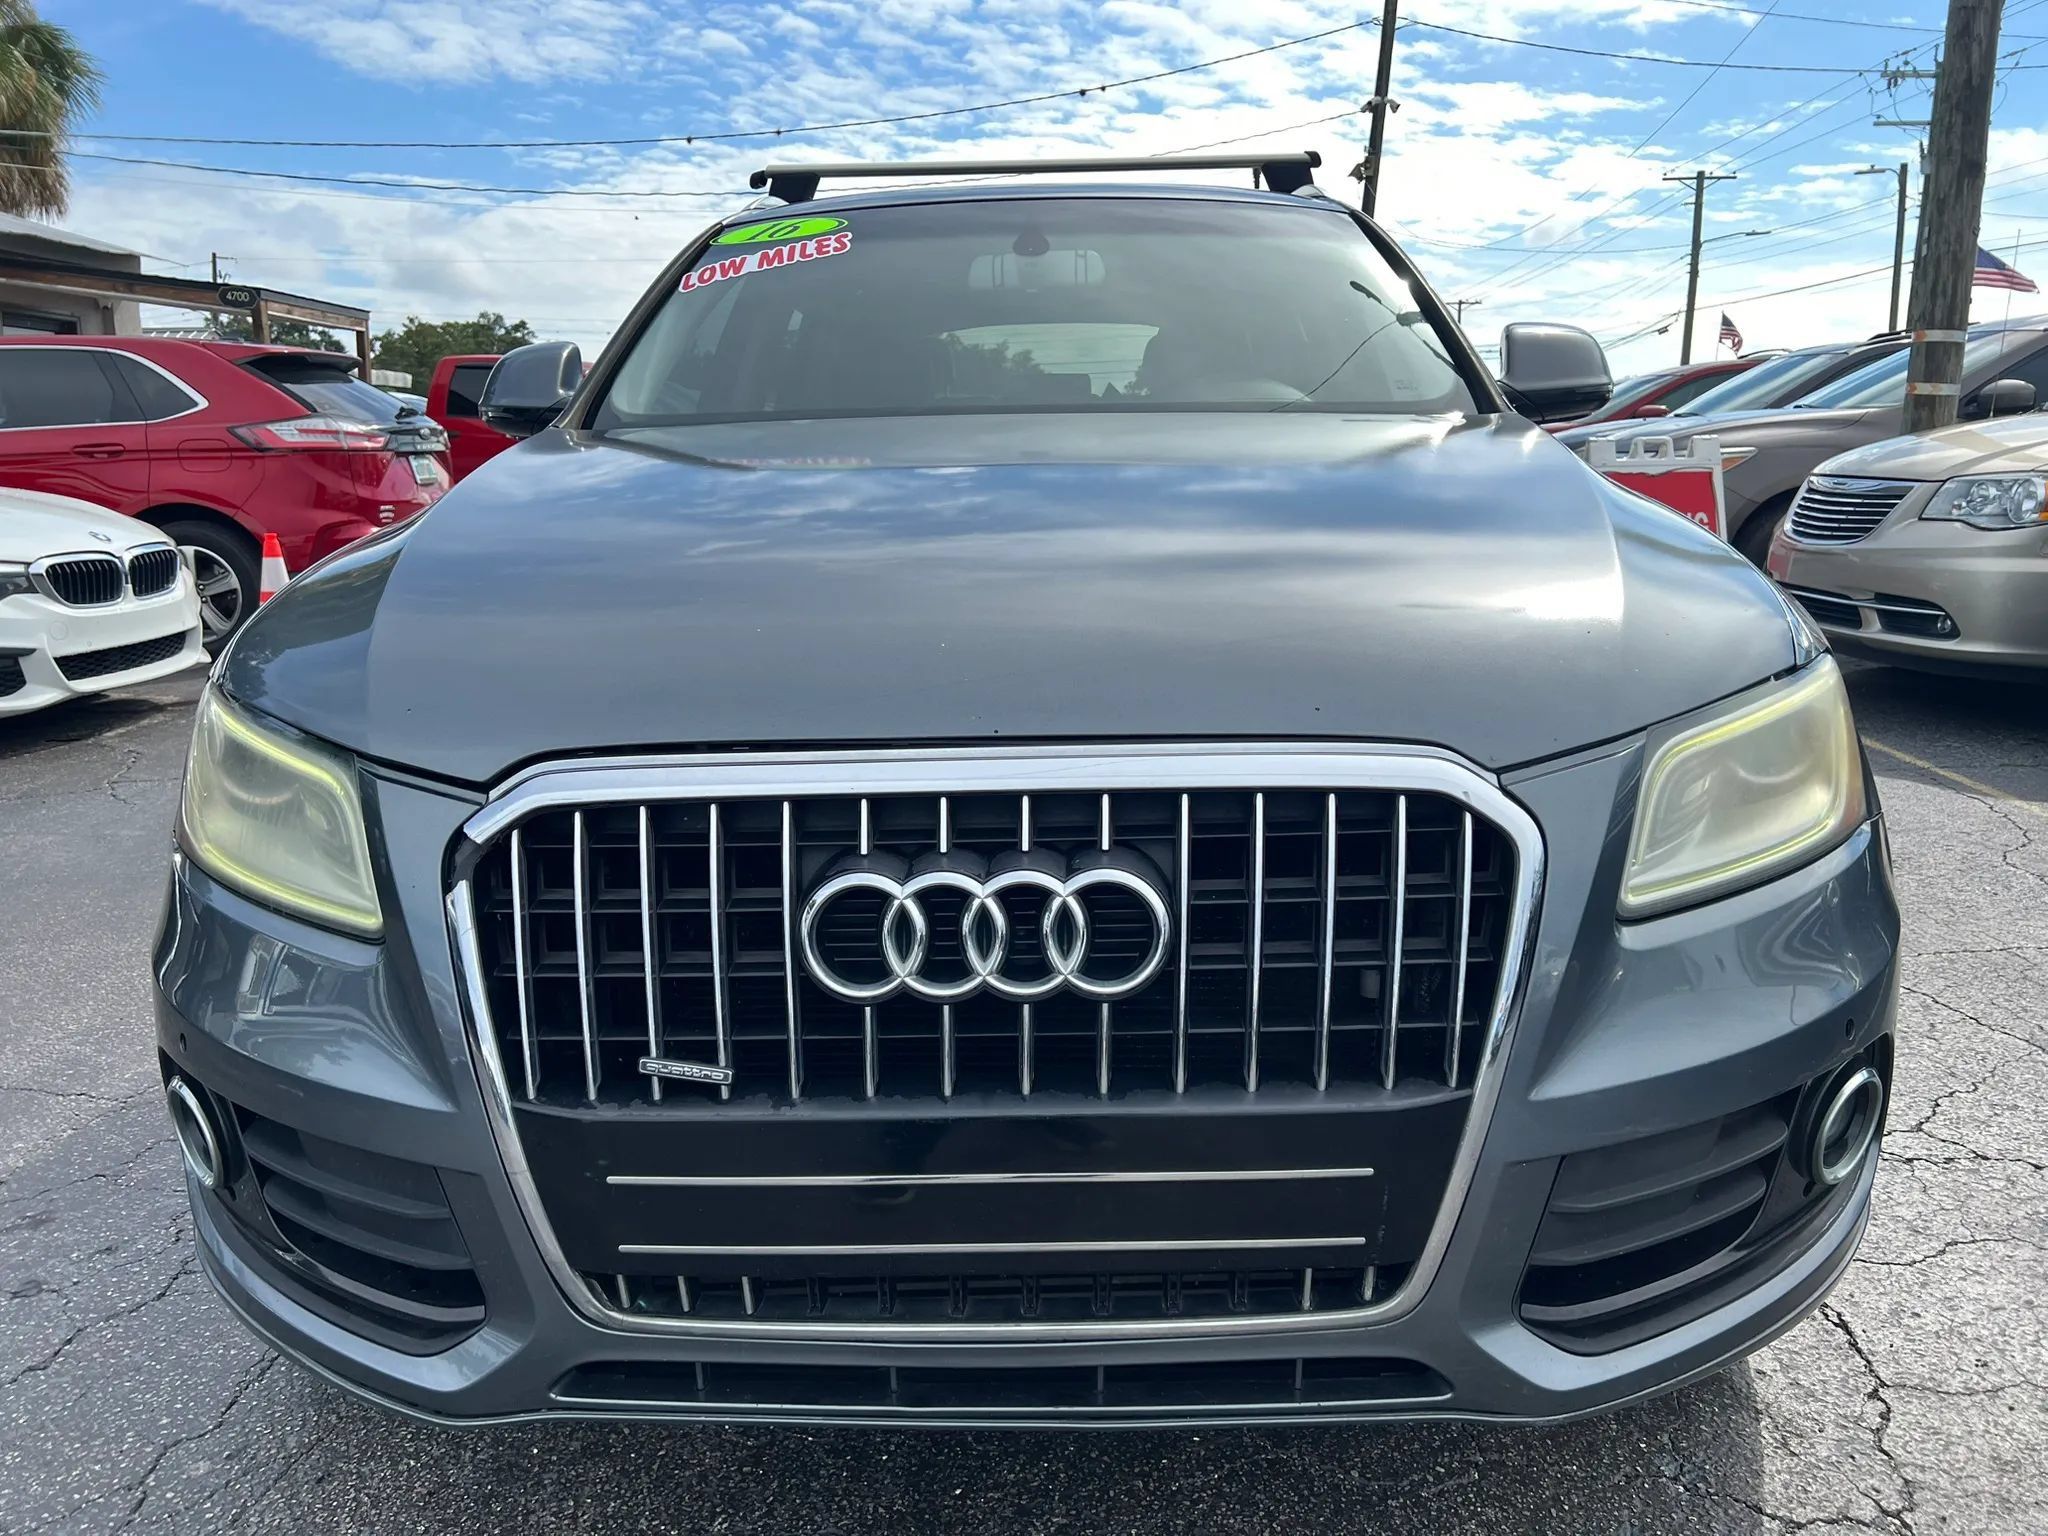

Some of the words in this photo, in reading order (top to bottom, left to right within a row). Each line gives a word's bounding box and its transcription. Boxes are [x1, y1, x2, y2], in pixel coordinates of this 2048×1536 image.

[742, 219, 809, 241] 16
[681, 257, 747, 291] LOW
[757, 233, 850, 270] MILES
[226, 291, 250, 302] 4700
[646, 1063, 724, 1080] quattro
